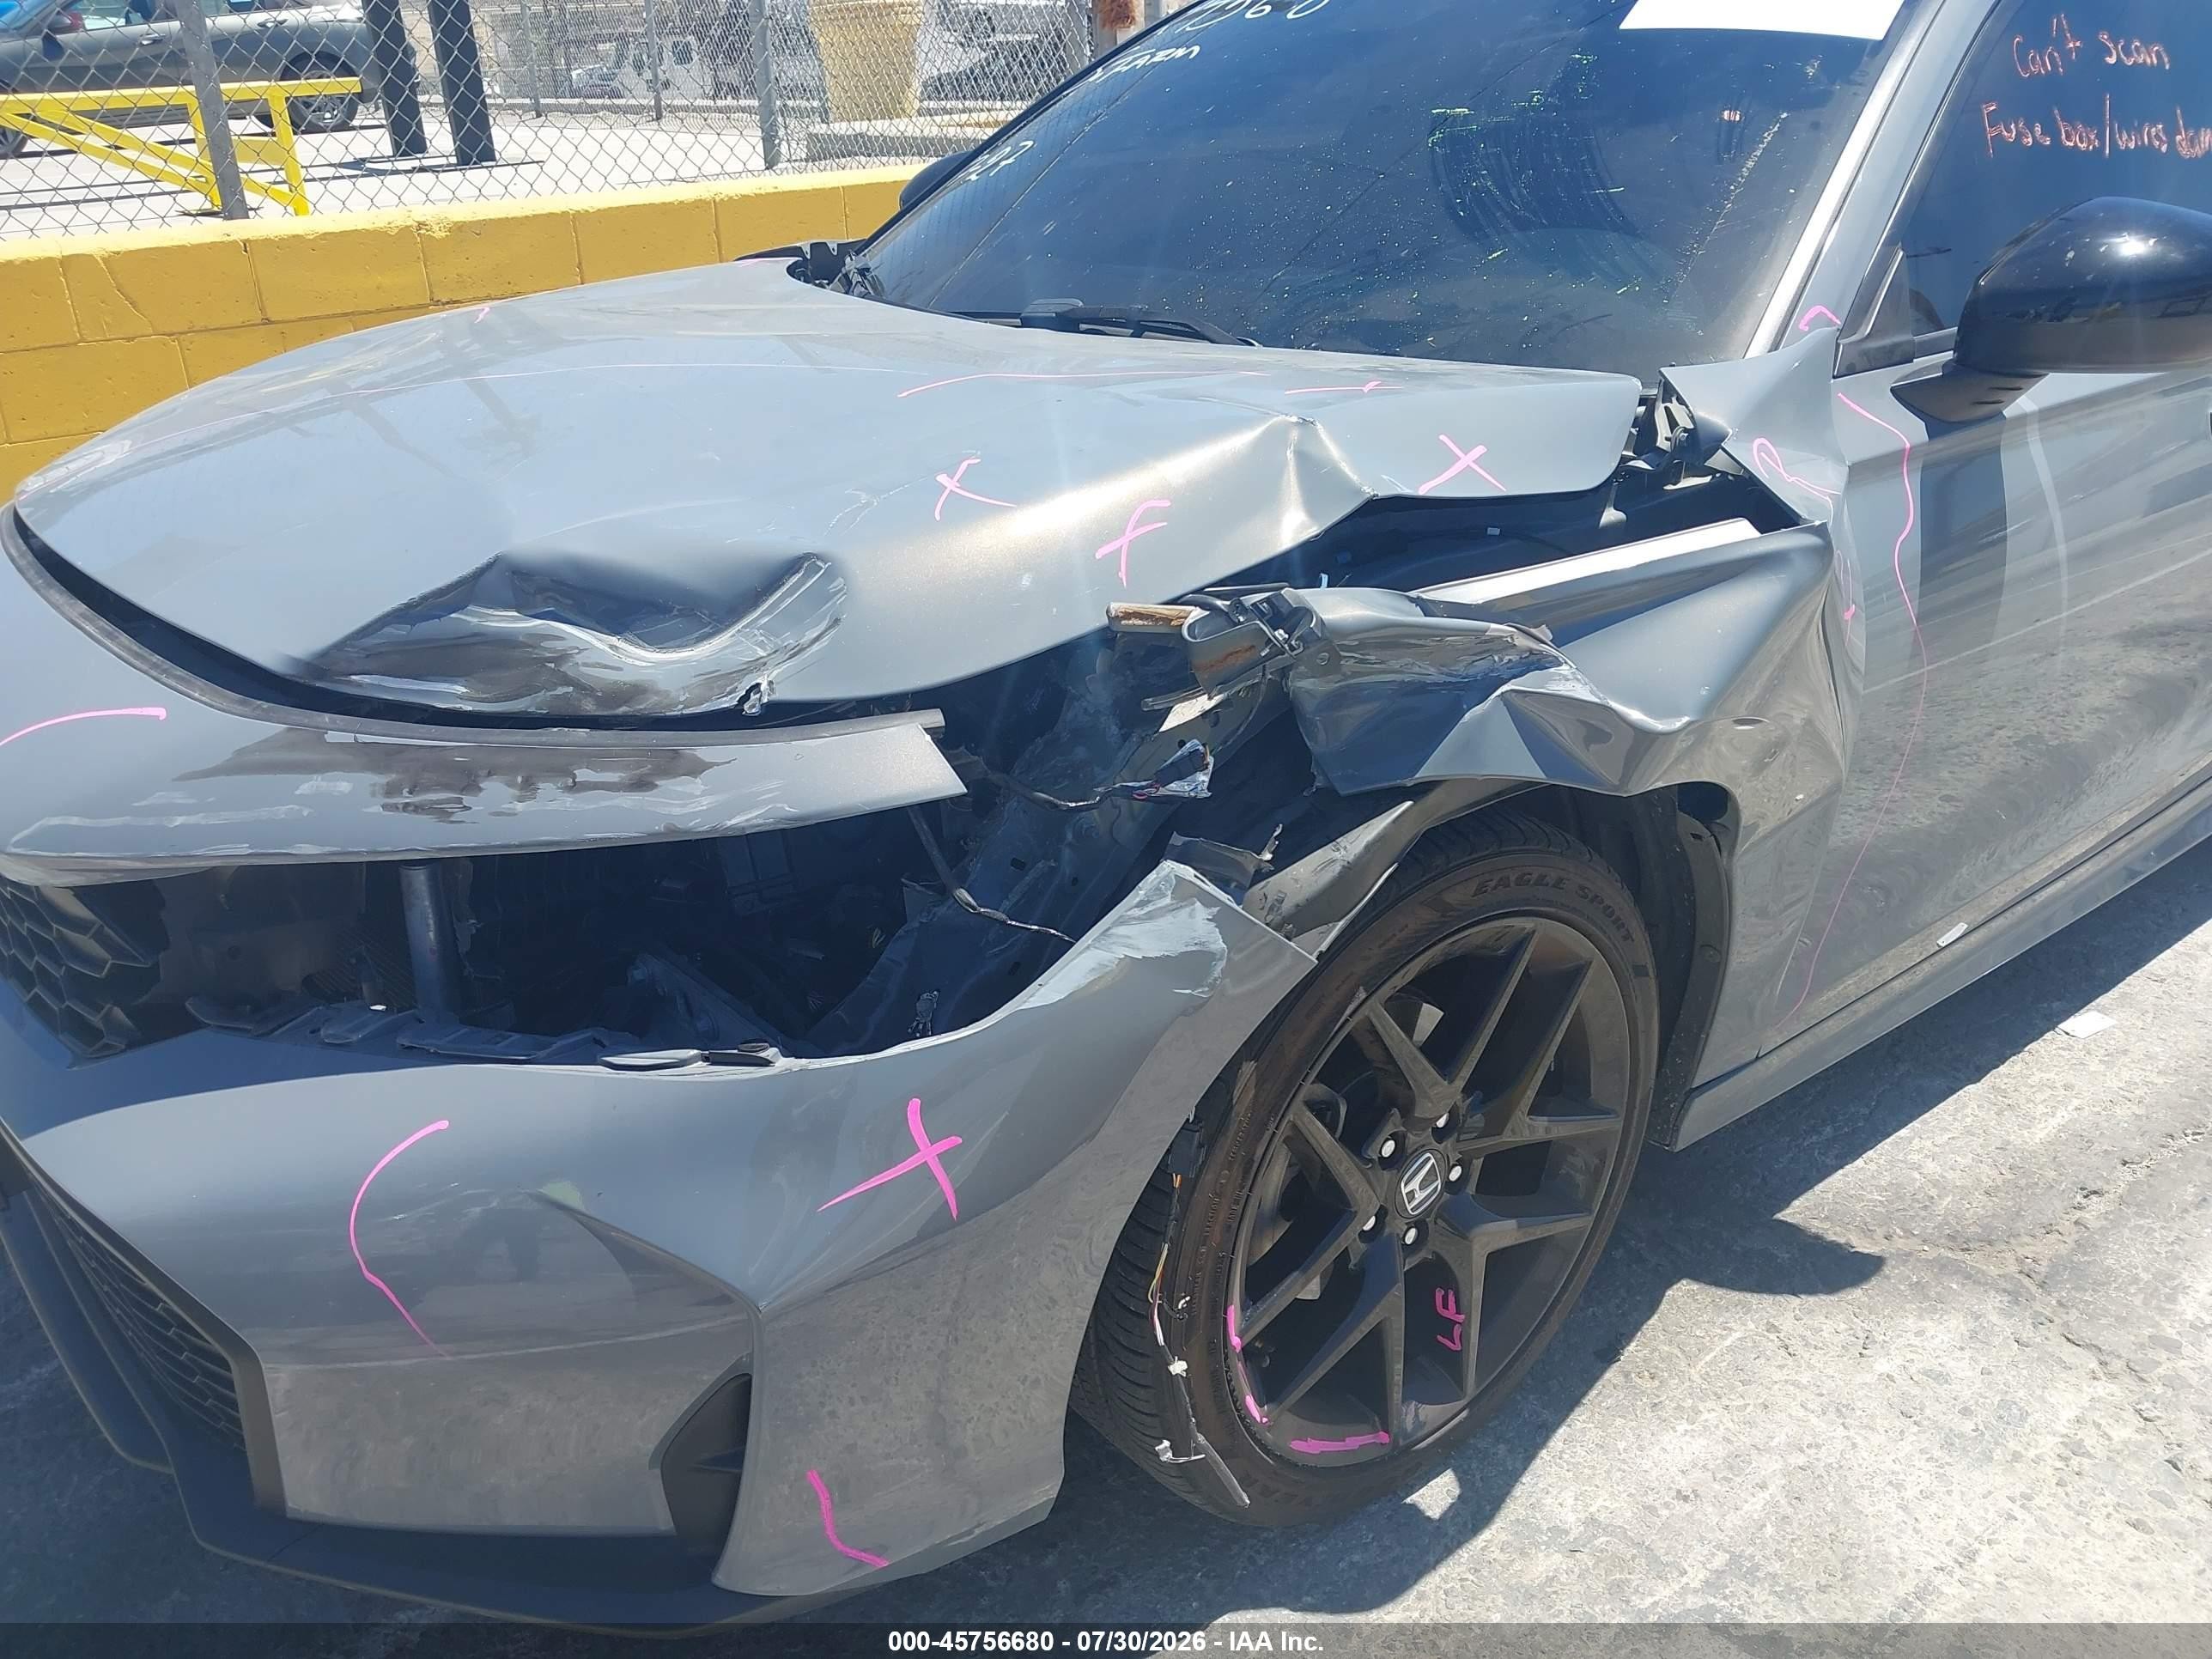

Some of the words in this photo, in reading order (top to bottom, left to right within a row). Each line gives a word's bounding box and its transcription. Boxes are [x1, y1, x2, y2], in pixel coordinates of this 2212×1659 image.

[1471, 871, 1569, 898] EAGLE
[1575, 884, 1635, 944] SPORT
[1435, 1288, 1465, 1351] LF
